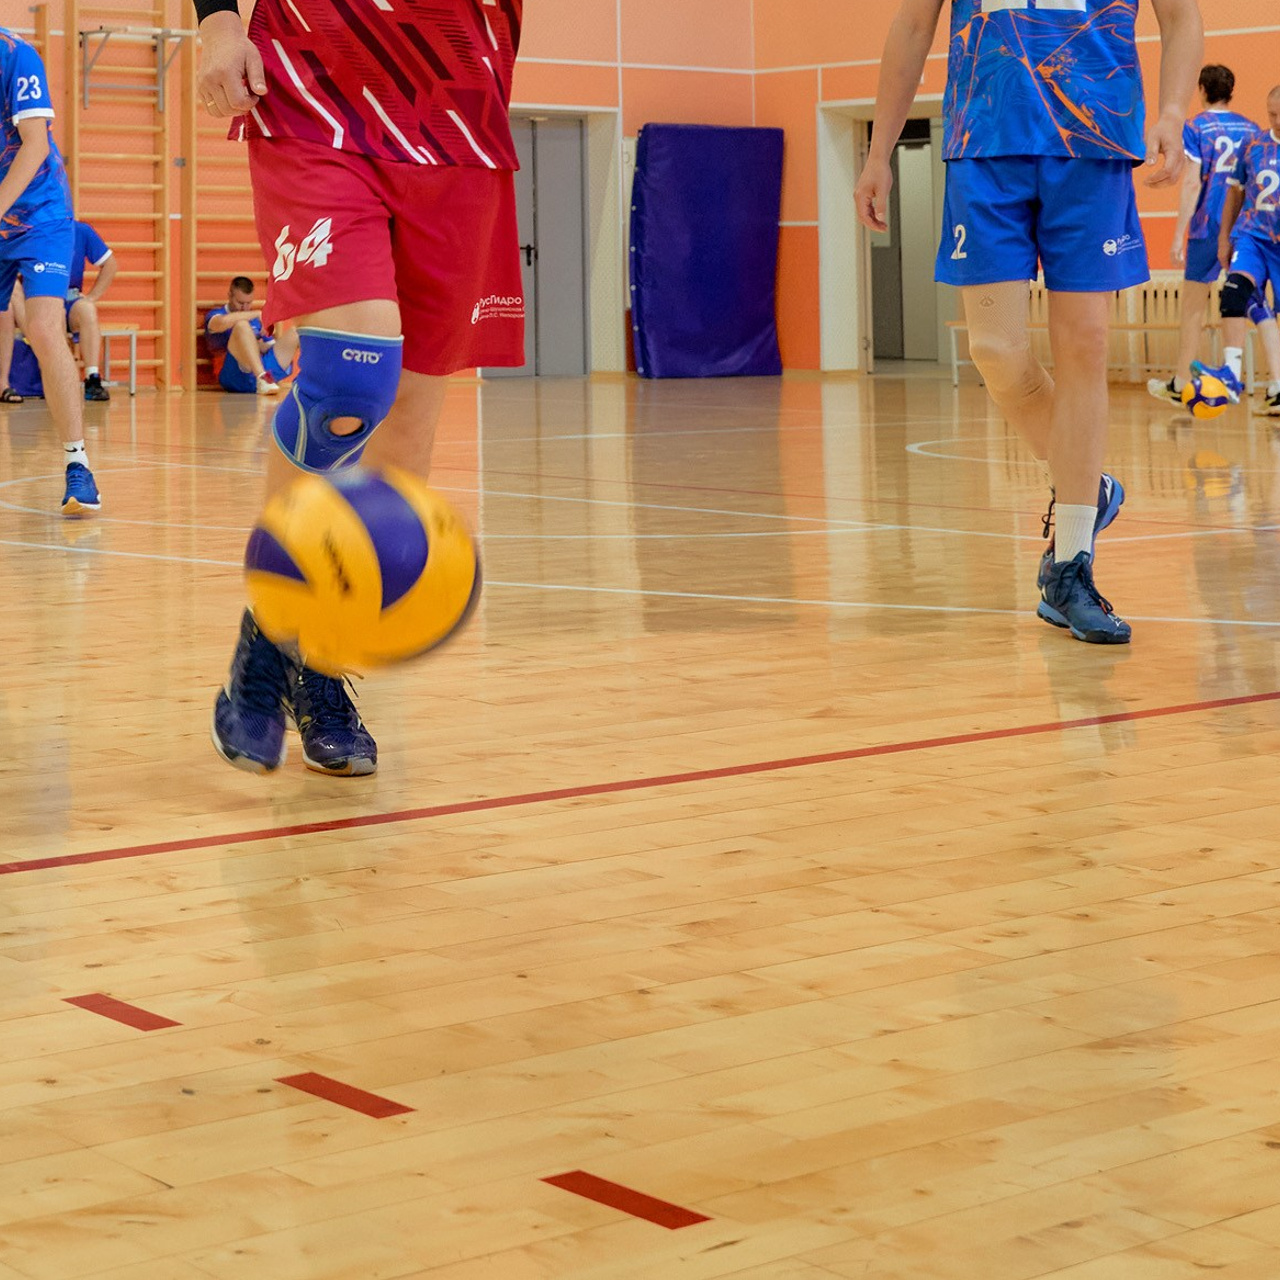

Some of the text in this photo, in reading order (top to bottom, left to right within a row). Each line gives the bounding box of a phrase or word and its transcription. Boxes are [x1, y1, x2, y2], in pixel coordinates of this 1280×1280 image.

[17, 74, 42, 101] 23
[273, 216, 334, 284] 64
[342, 348, 380, 365] ORTO
